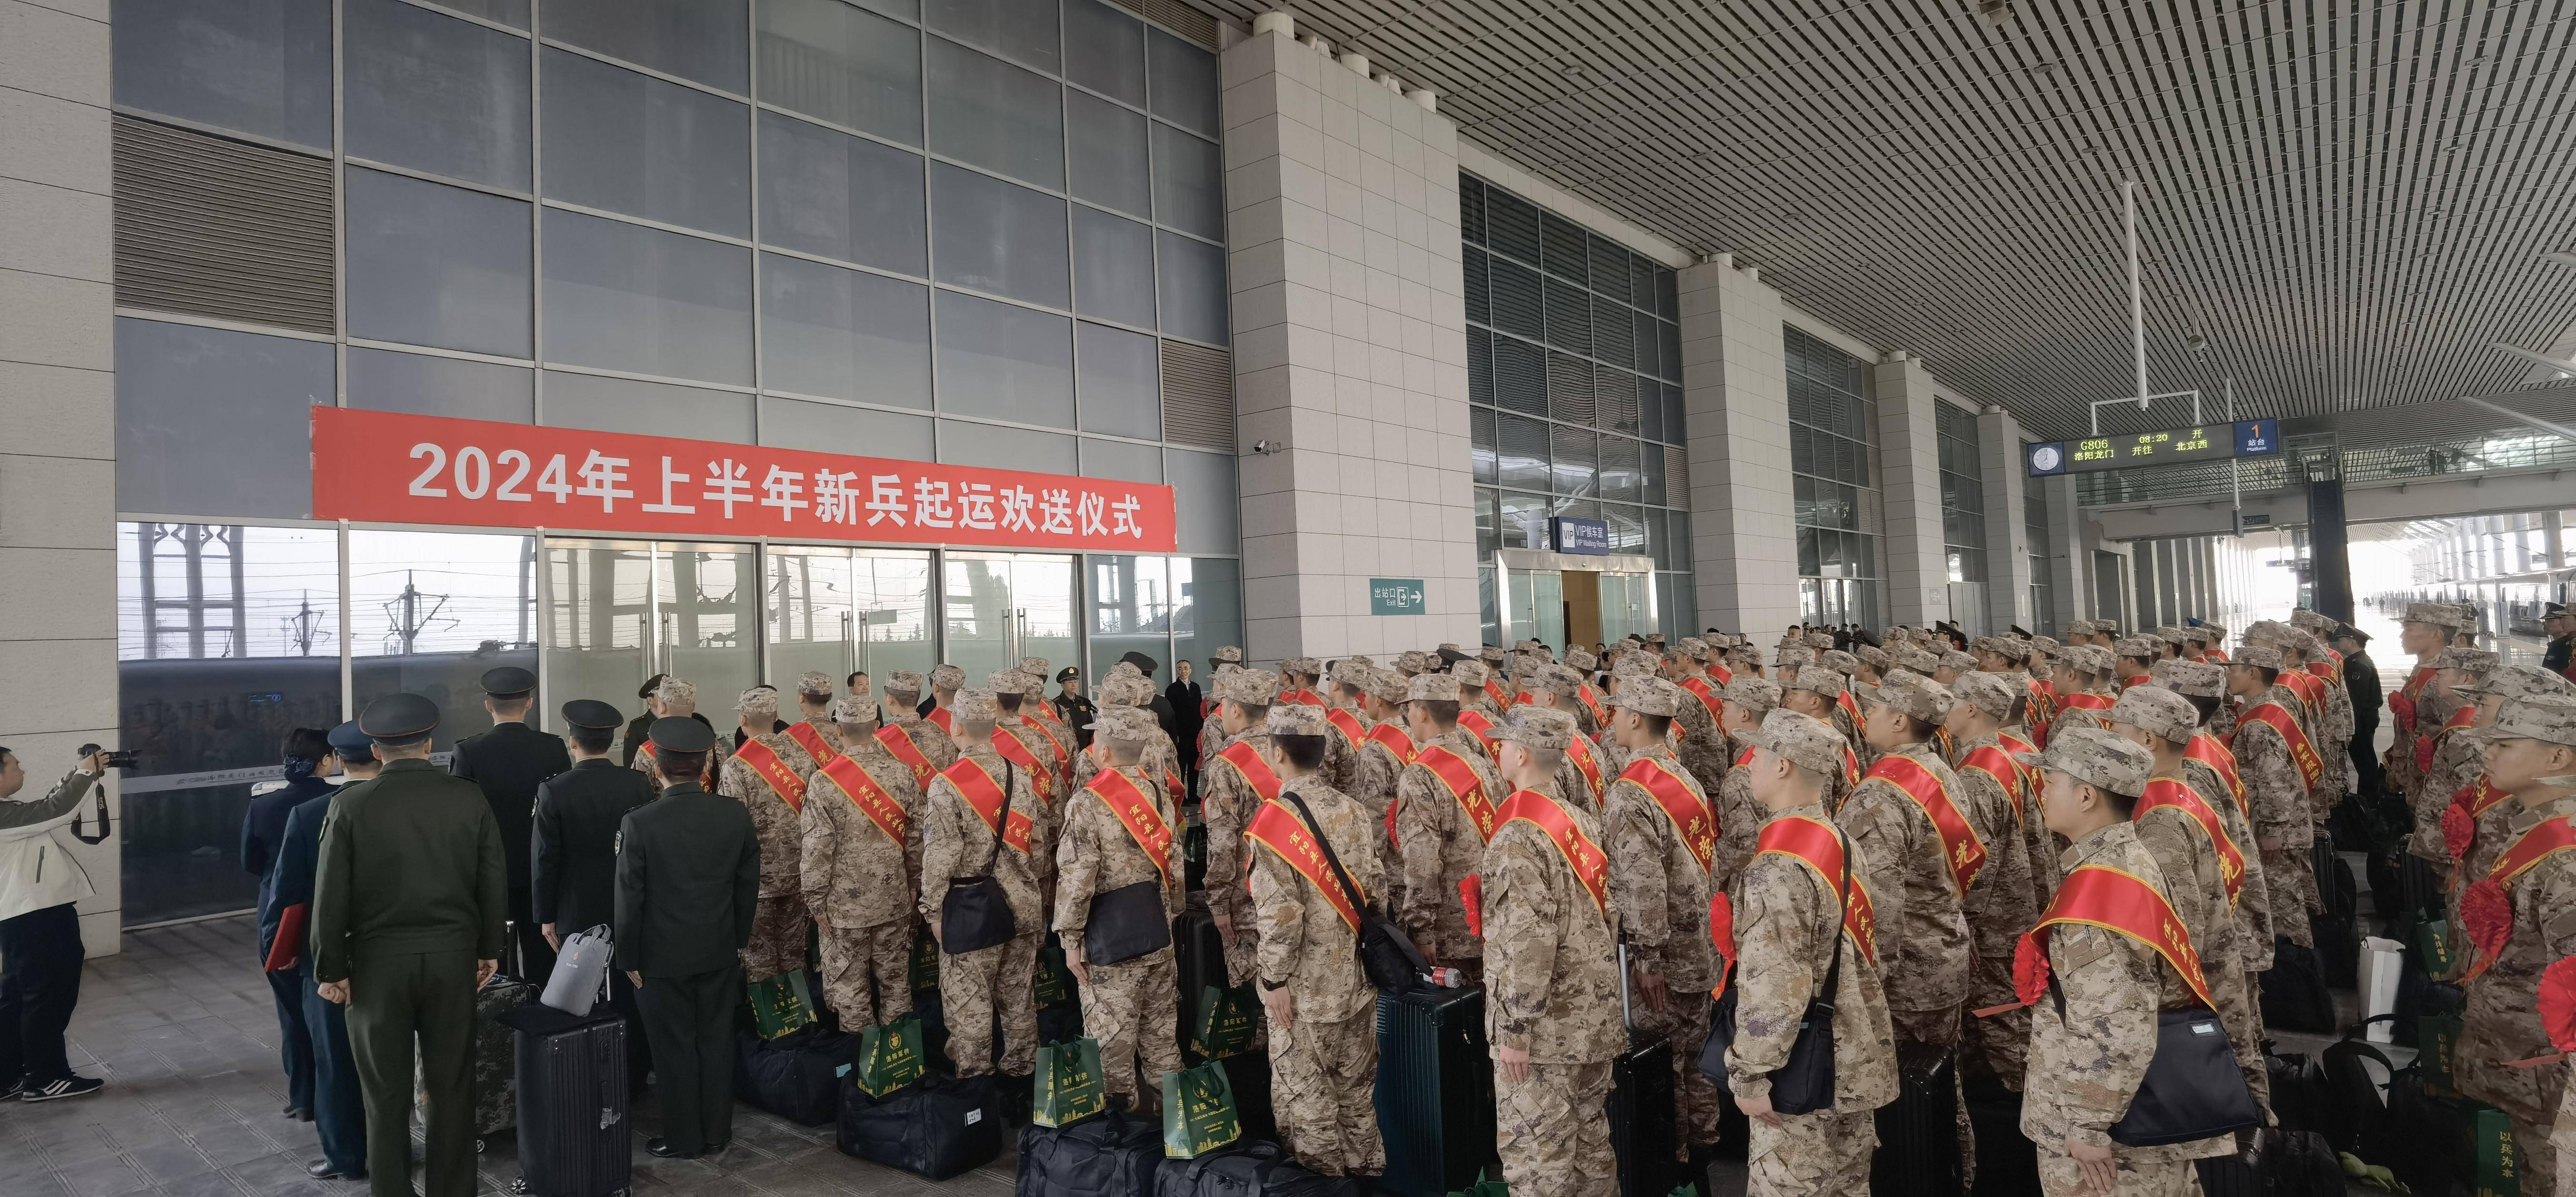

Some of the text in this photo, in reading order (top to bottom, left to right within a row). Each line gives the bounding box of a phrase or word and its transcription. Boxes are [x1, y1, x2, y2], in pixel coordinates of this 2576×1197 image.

[2252, 424, 2259, 438] 1
[2081, 429, 2202, 450] G806 08:20 开
[2248, 438, 2265, 446] 站台
[2074, 440, 2207, 461] 洛阳龙门 开往 北京西
[408, 443, 1142, 539] 2024年上半年新兵起运欢送仪式
[1563, 530, 1573, 540] VIP
[1575, 525, 1603, 538] VIP候车室
[1375, 587, 1395, 598] 出站口
[2500, 1131, 2514, 1178] 以兵为本
